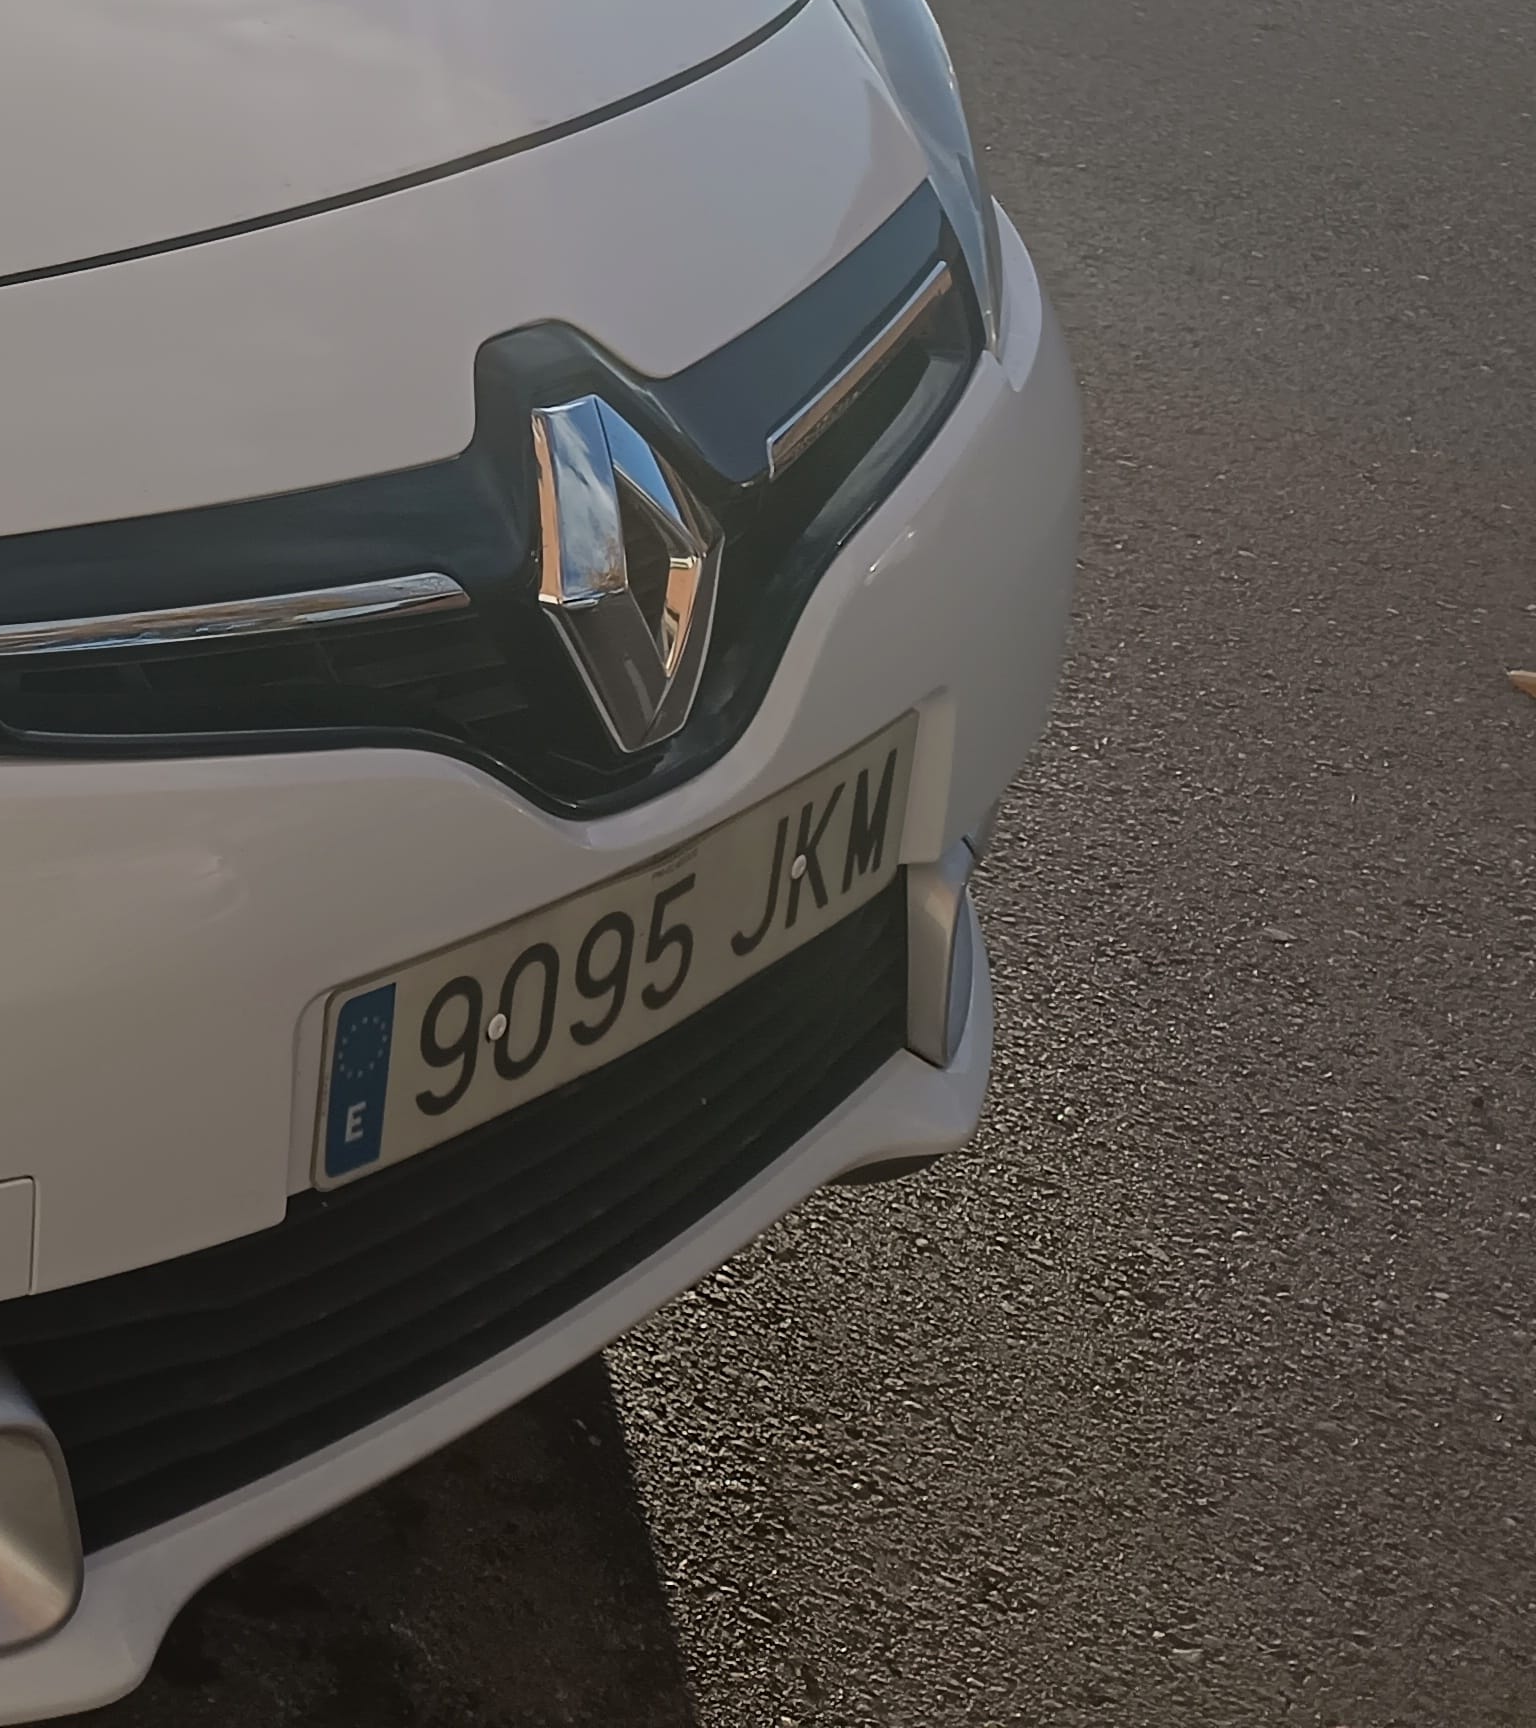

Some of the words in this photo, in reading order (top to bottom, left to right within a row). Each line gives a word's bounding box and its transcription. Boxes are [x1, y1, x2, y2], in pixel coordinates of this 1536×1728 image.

[344, 1101, 367, 1143] E
[415, 873, 696, 1116] 9095
[730, 748, 898, 956] JKM
